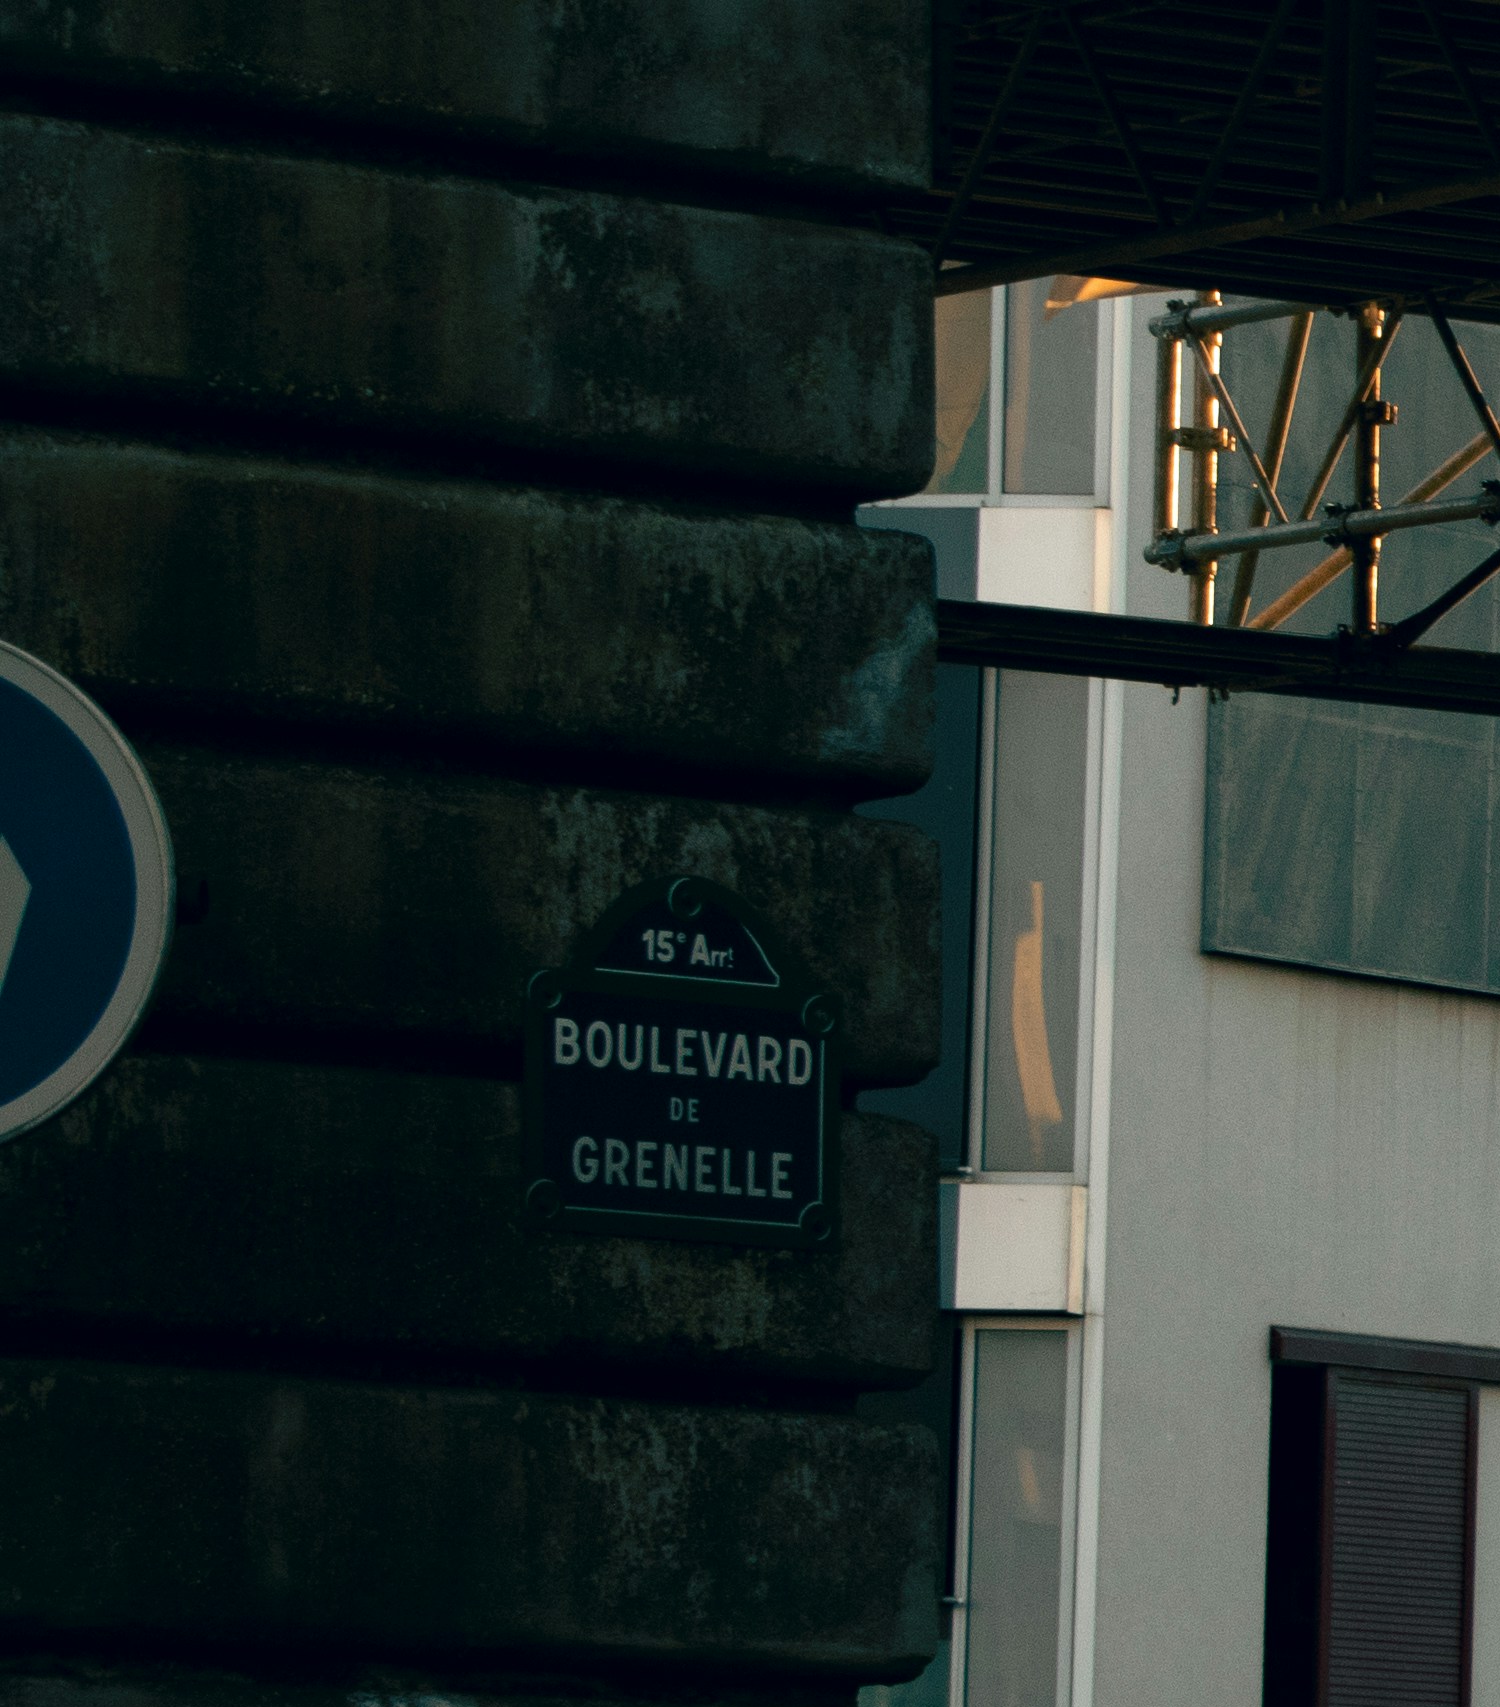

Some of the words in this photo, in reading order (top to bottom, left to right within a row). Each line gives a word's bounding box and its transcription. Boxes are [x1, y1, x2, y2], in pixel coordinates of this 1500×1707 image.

[554, 1017, 812, 1086] BOULEVARD
[670, 1096, 700, 1123] DE
[572, 1136, 793, 1199] GRENELLE
